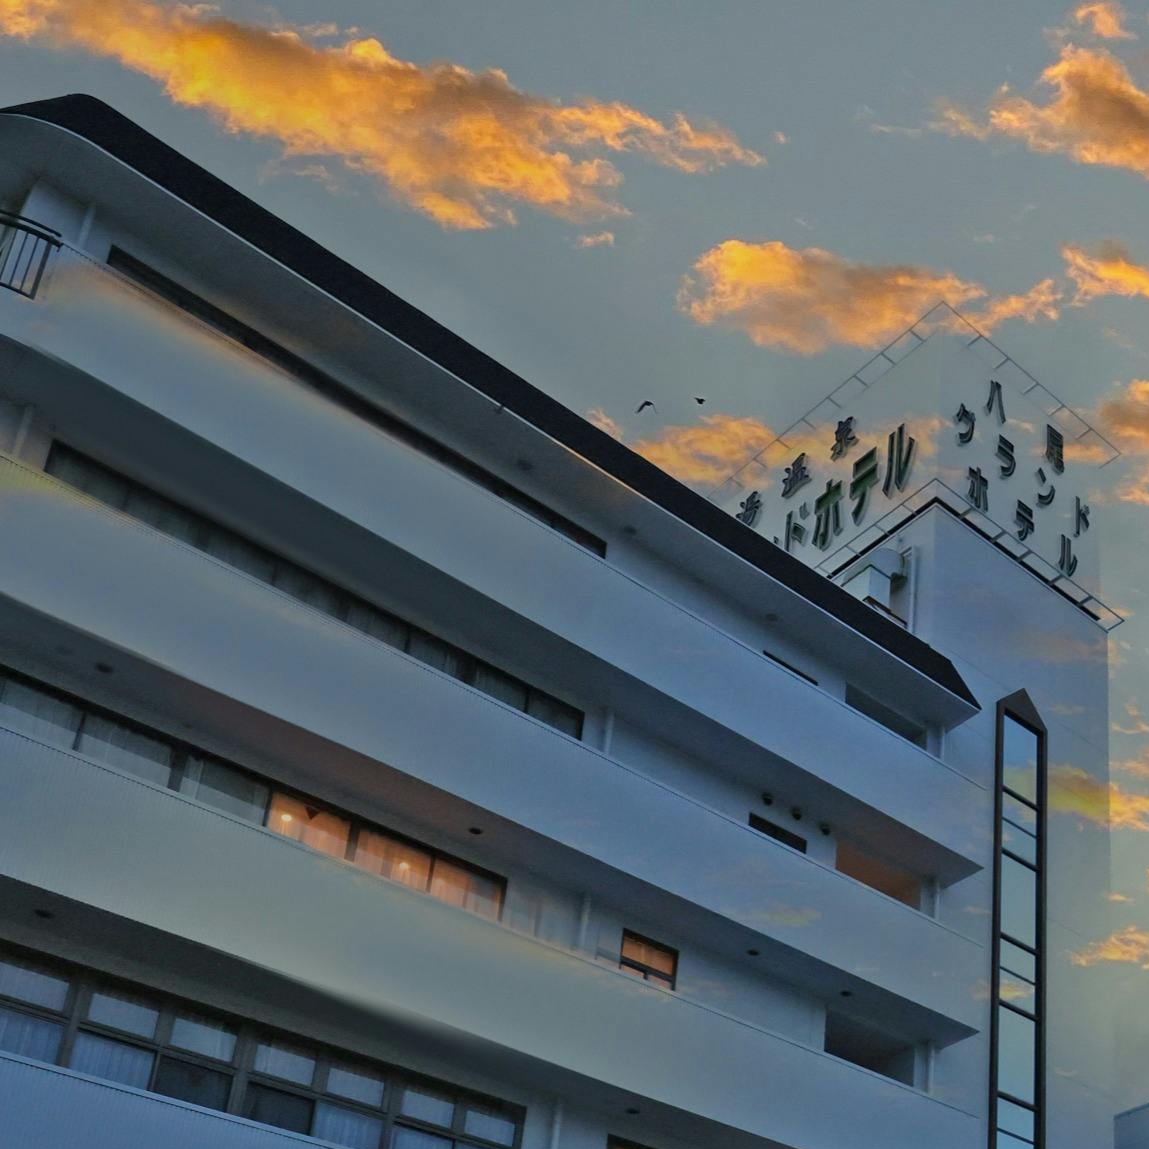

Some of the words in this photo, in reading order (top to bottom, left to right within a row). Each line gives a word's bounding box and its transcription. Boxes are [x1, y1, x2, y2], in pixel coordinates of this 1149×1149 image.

[774, 422, 917, 552] ドホテル
[955, 402, 1091, 538] グランド
[967, 466, 1079, 578] ホテル
